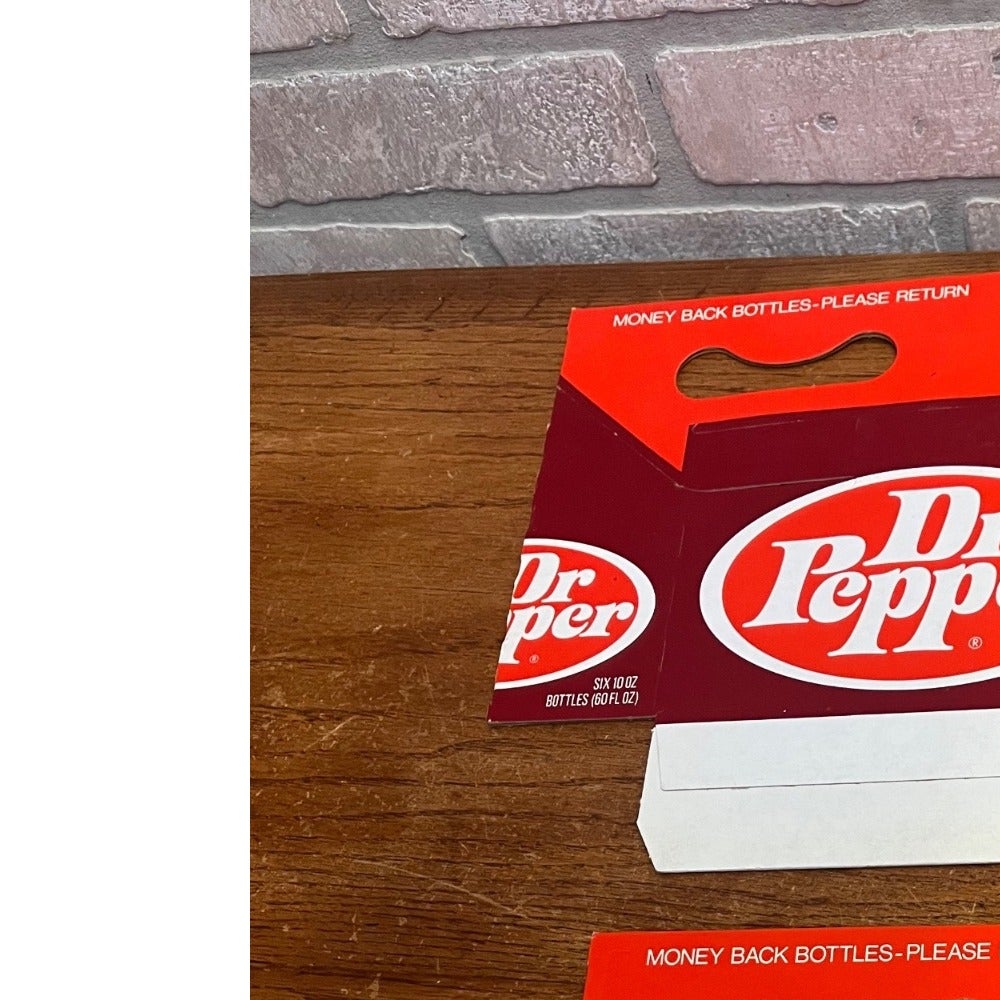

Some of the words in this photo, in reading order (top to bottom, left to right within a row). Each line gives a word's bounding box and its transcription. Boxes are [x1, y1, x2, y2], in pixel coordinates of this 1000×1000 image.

[613, 310, 677, 327] MONEY
[680, 306, 728, 322] BACK
[896, 284, 970, 303] RETURN
[498, 602, 634, 665] per
[593, 677, 611, 690] SIX
[613, 676, 624, 689] 10
[625, 675, 638, 689] OZ
[545, 693, 589, 707] BOTTLES
[622, 691, 639, 706] OZ)
[645, 948, 724, 966] MONEY
[730, 946, 788, 965] BACK
